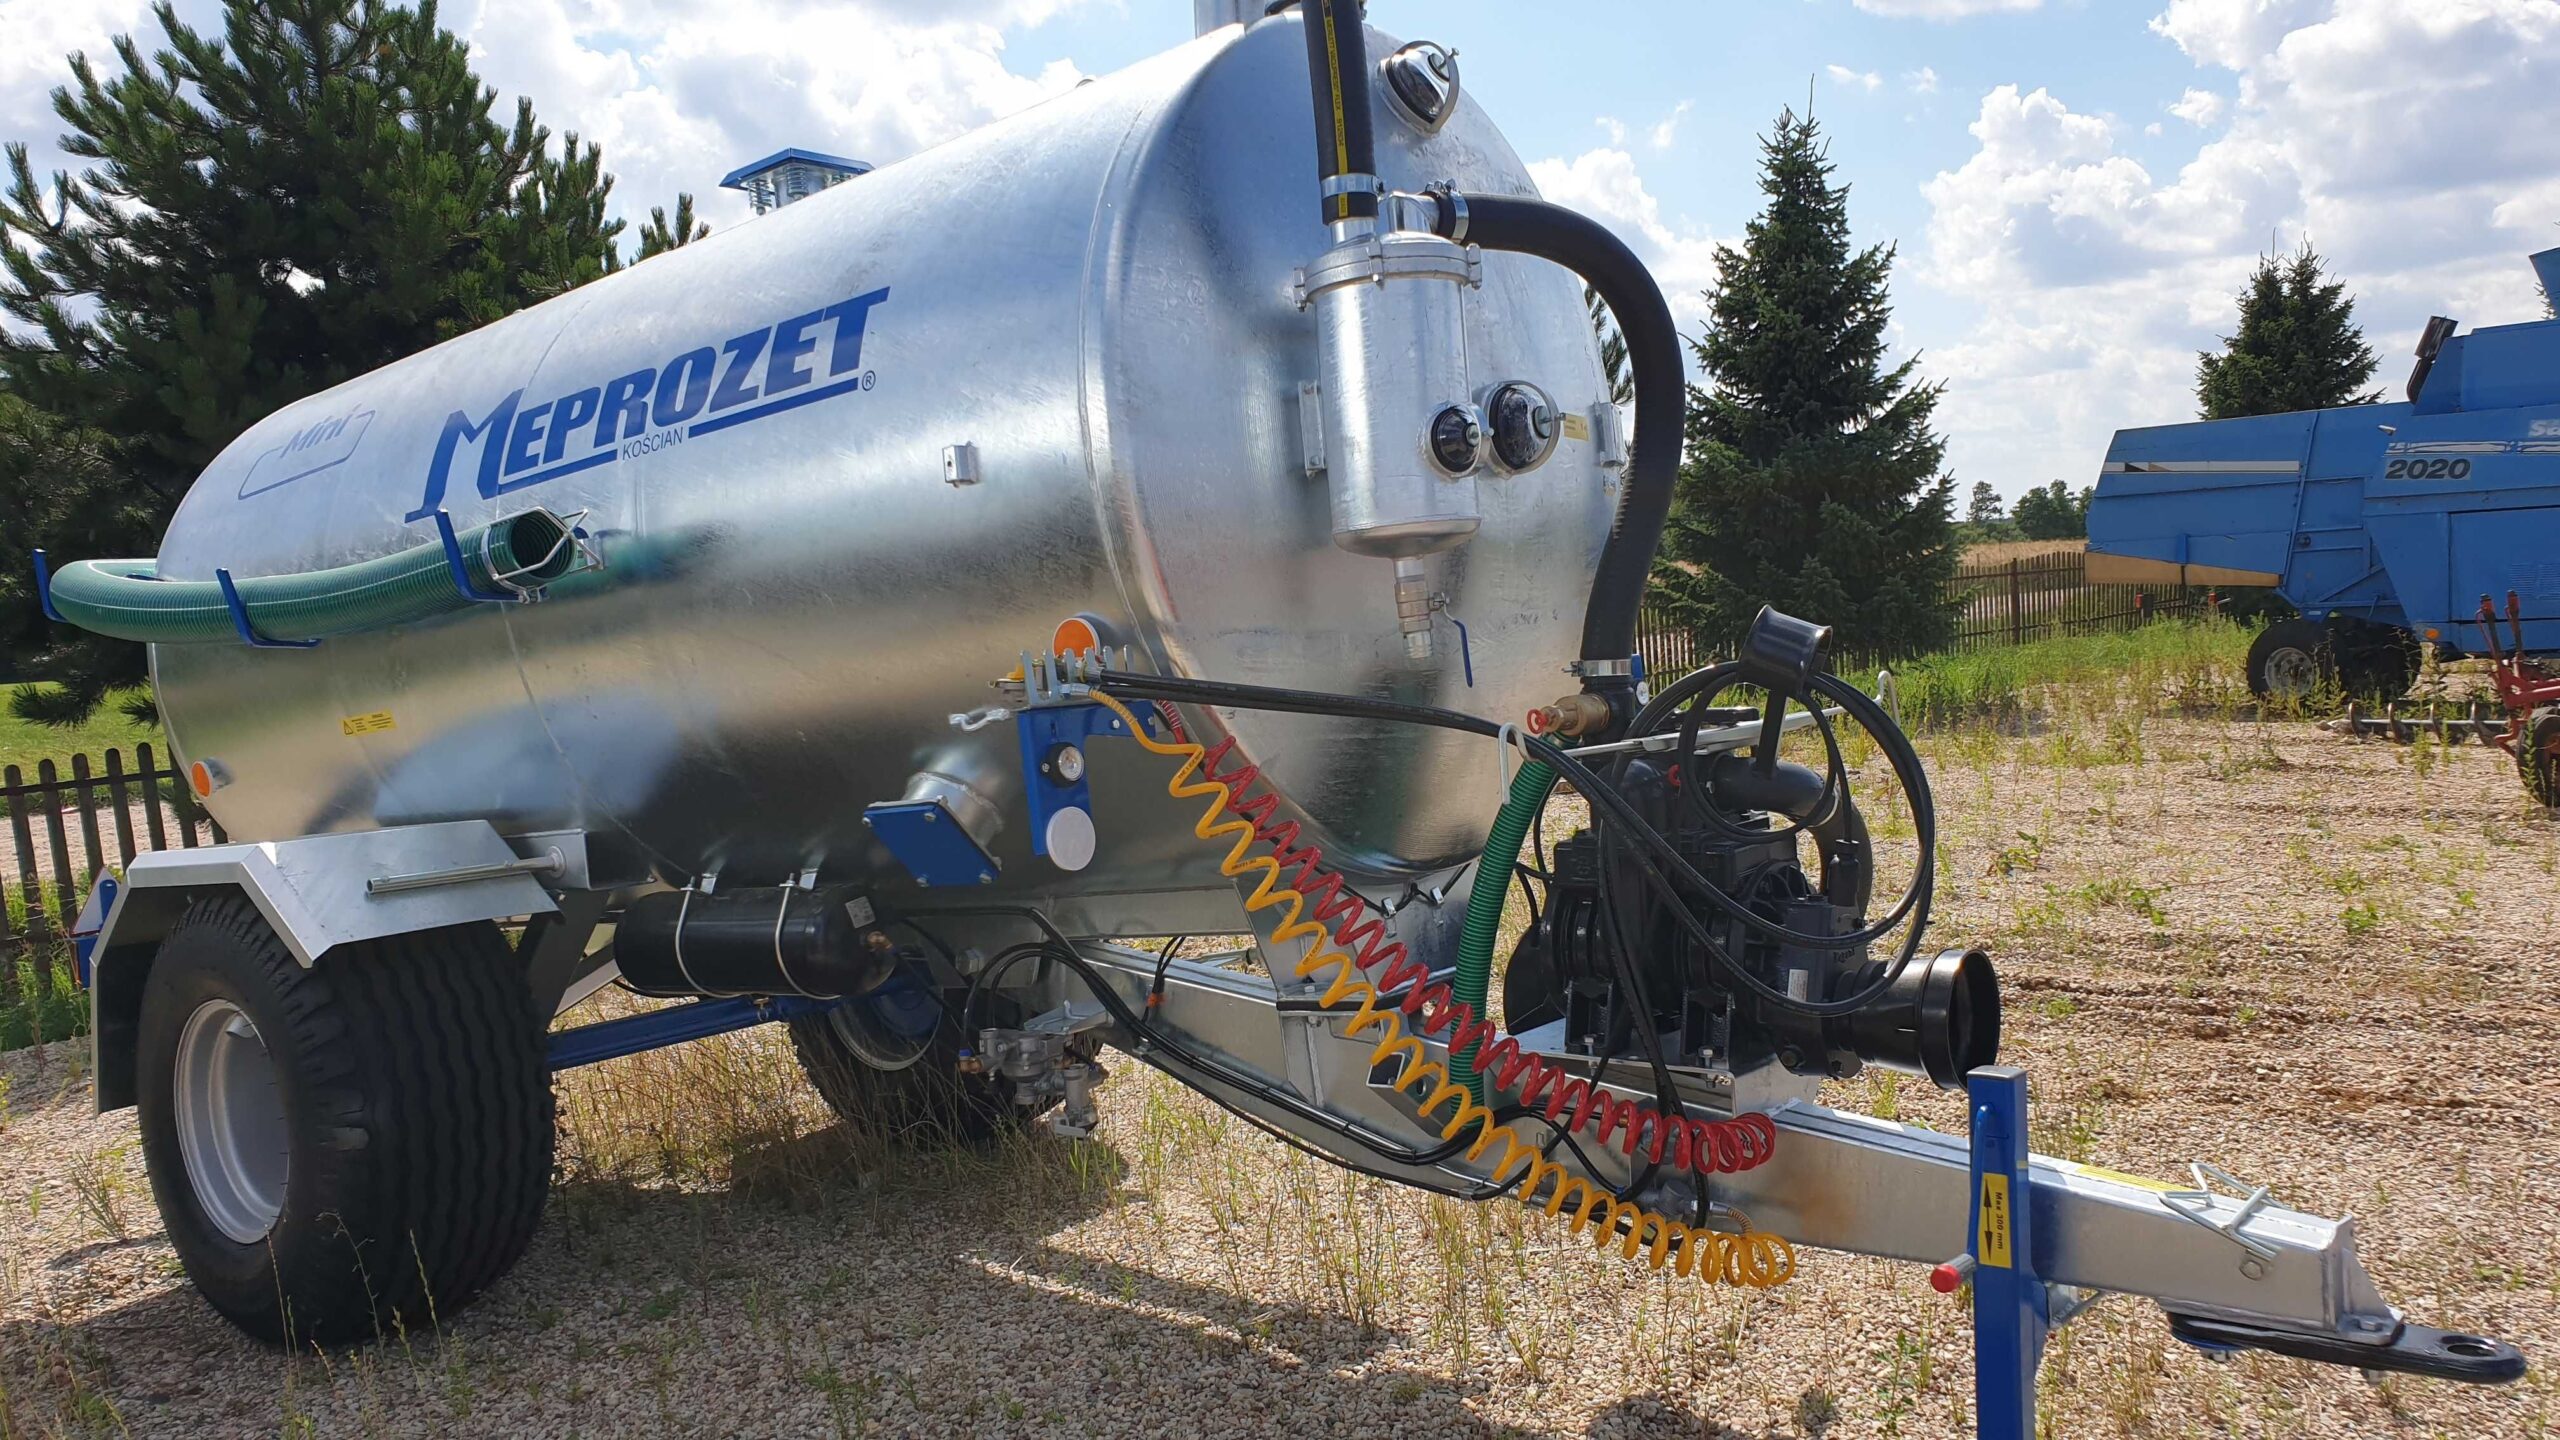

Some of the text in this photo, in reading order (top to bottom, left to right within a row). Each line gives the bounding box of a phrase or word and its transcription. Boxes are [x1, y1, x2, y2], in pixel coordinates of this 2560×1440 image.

[280, 404, 362, 458] Mini
[405, 287, 890, 523] MEPROZET
[623, 426, 683, 460] KOŚCIAN
[2385, 458, 2471, 480] 2020
[1995, 1192, 2004, 1249] Max 300 mm
